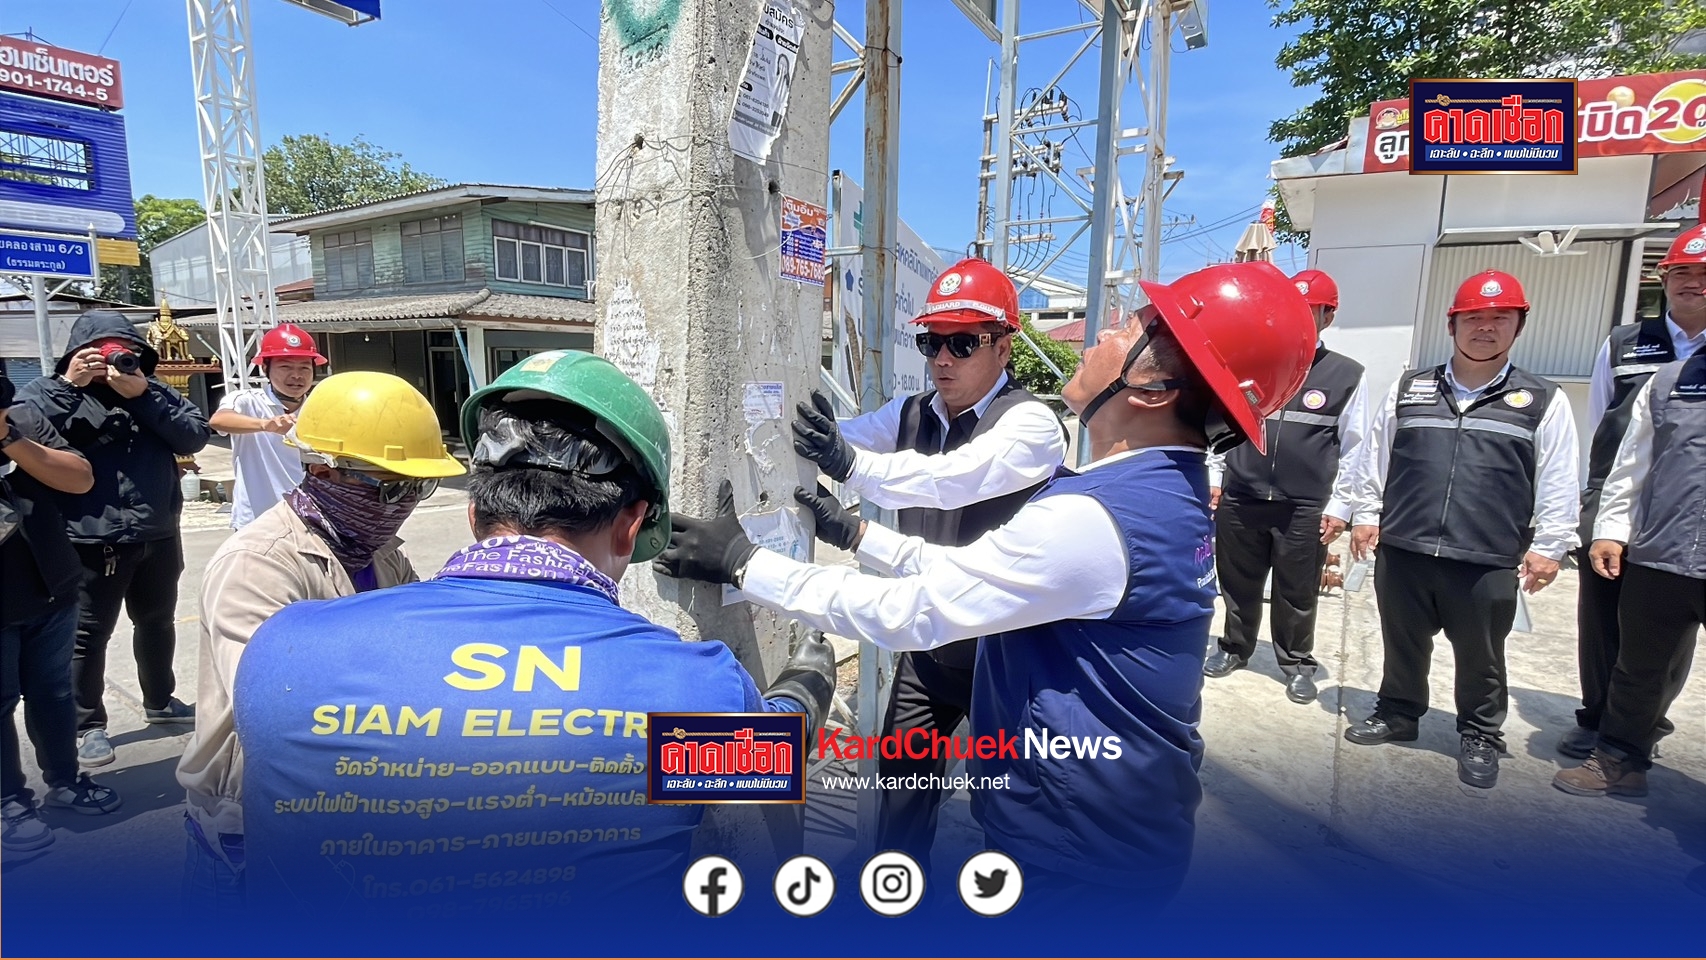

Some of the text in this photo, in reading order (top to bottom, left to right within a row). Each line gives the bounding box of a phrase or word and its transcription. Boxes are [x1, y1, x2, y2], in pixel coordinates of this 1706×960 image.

[58, 244, 84, 255] 6/3
[463, 550, 501, 563] The
[443, 642, 582, 692] SN
[311, 704, 443, 737] SIAM
